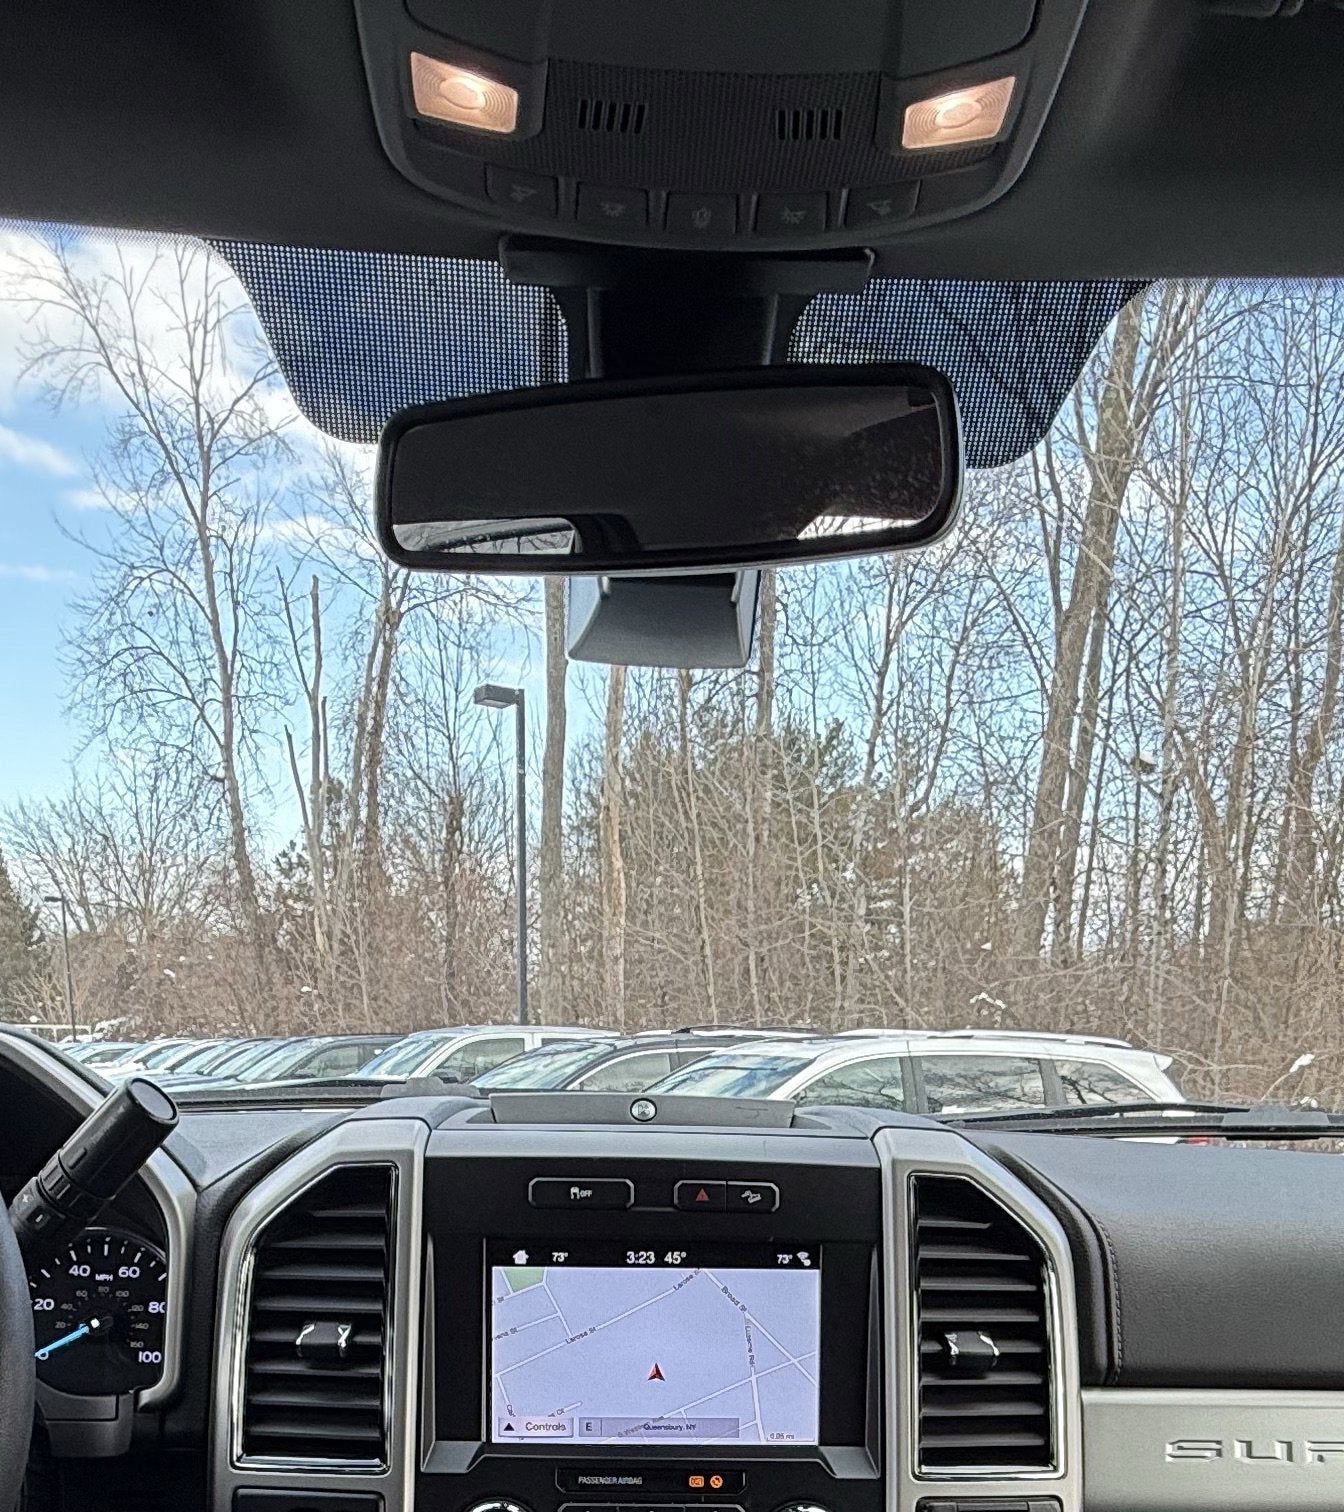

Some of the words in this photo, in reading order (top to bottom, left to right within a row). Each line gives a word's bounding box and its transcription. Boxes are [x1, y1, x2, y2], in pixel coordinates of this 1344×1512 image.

[579, 1189, 593, 1198] OFF
[626, 1251, 656, 1264] 3:23
[663, 1251, 687, 1264] 45°
[68, 1265, 91, 1277] 40
[118, 1266, 140, 1278] 60
[33, 1298, 55, 1311] 20
[138, 1350, 162, 1363] 100
[525, 1421, 567, 1432] Controls
[585, 1422, 593, 1432] E
